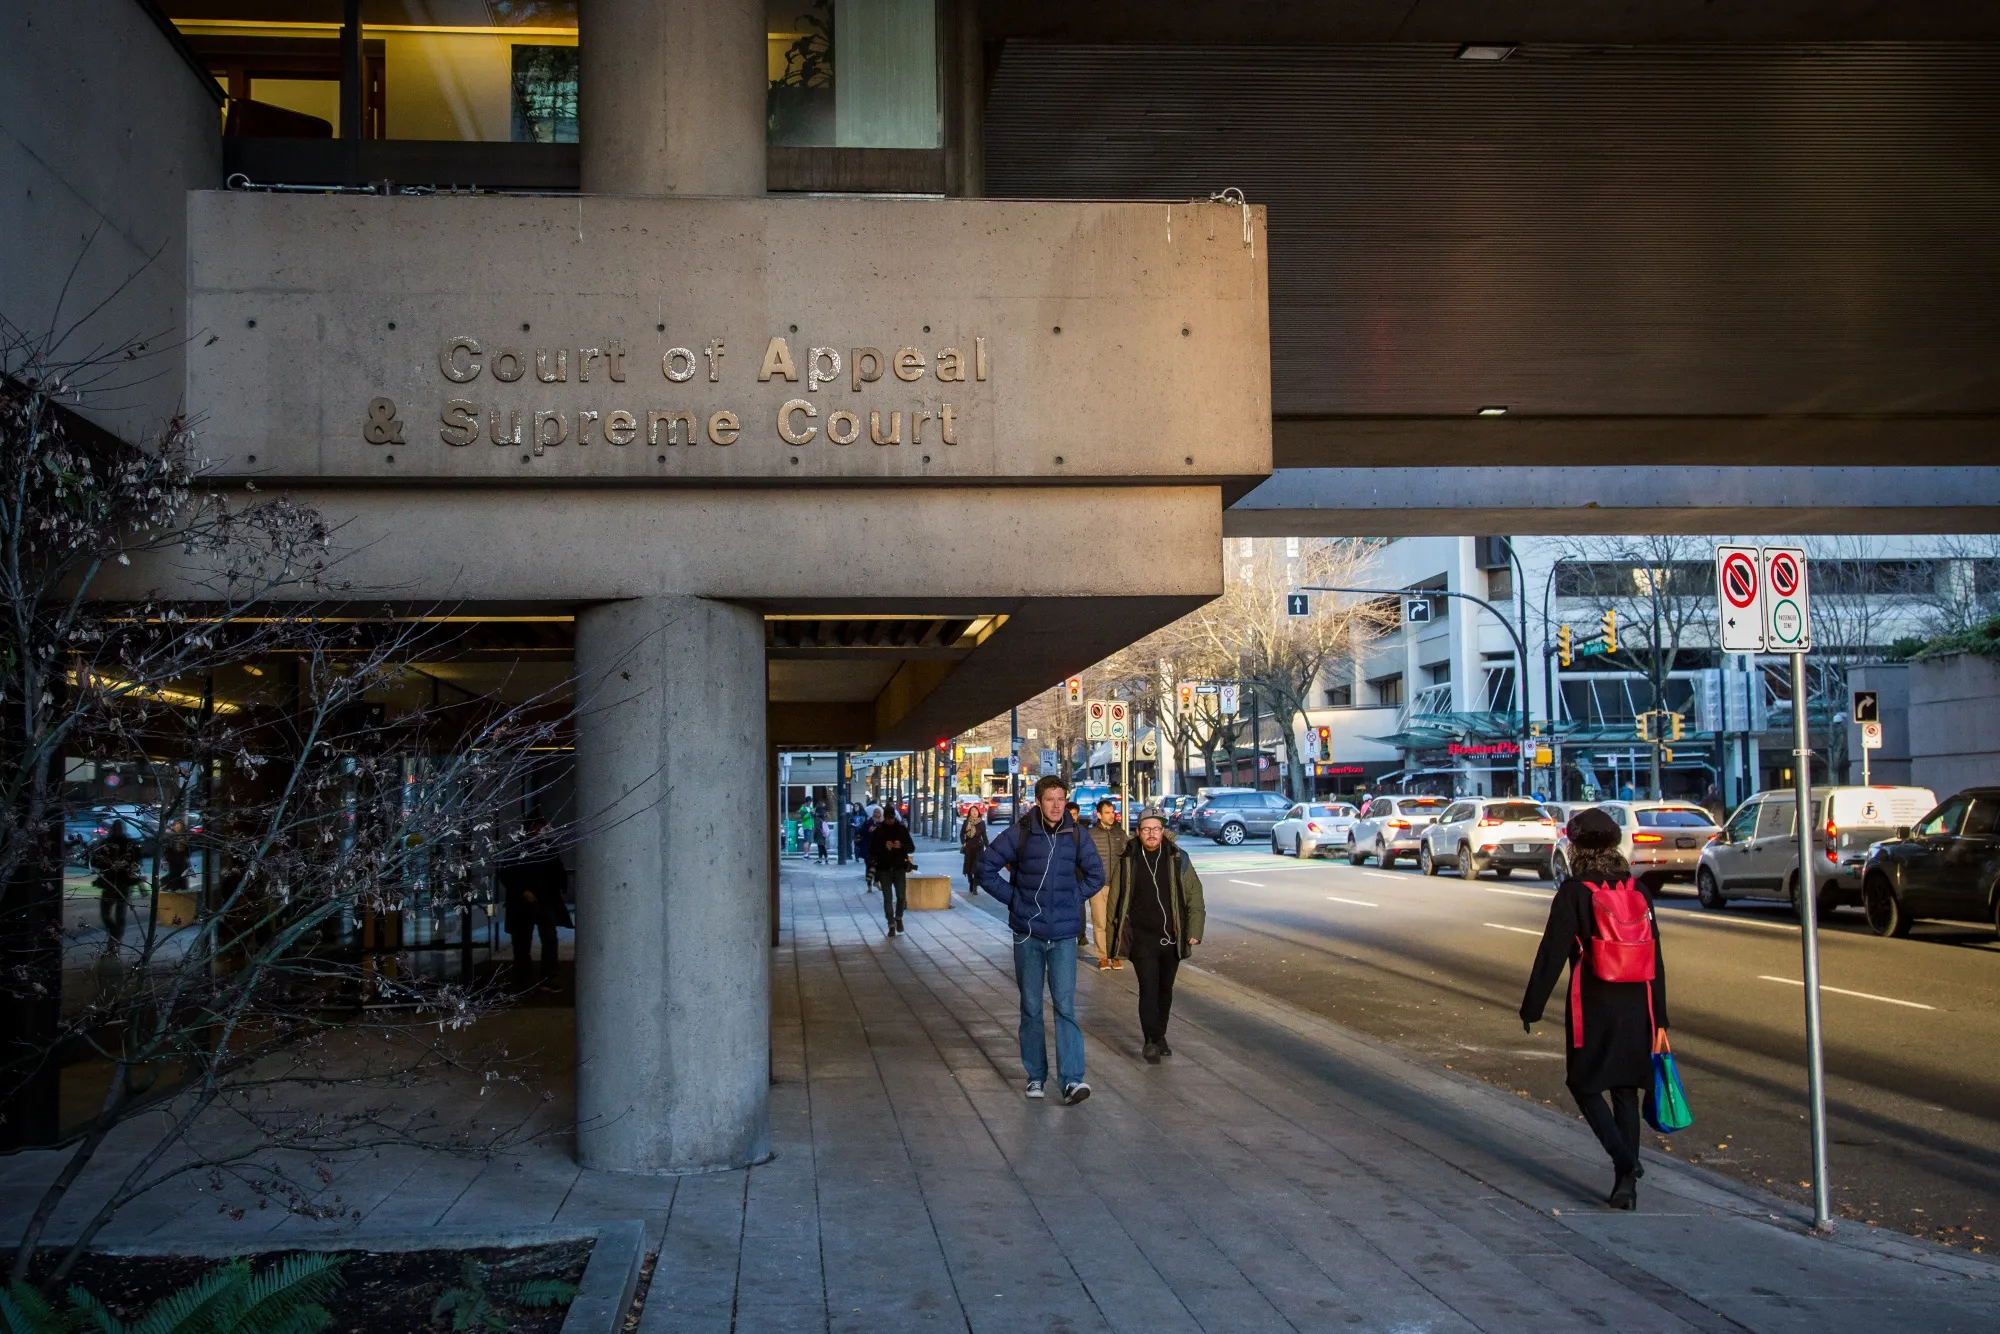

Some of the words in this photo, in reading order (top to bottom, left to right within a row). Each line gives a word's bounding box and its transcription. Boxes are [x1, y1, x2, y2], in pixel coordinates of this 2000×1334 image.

[440, 336, 626, 383] Court
[661, 338, 725, 383] of
[757, 337, 987, 392] Appeal
[363, 397, 405, 445] &
[441, 398, 740, 456] Supreme
[777, 398, 957, 445] Court
